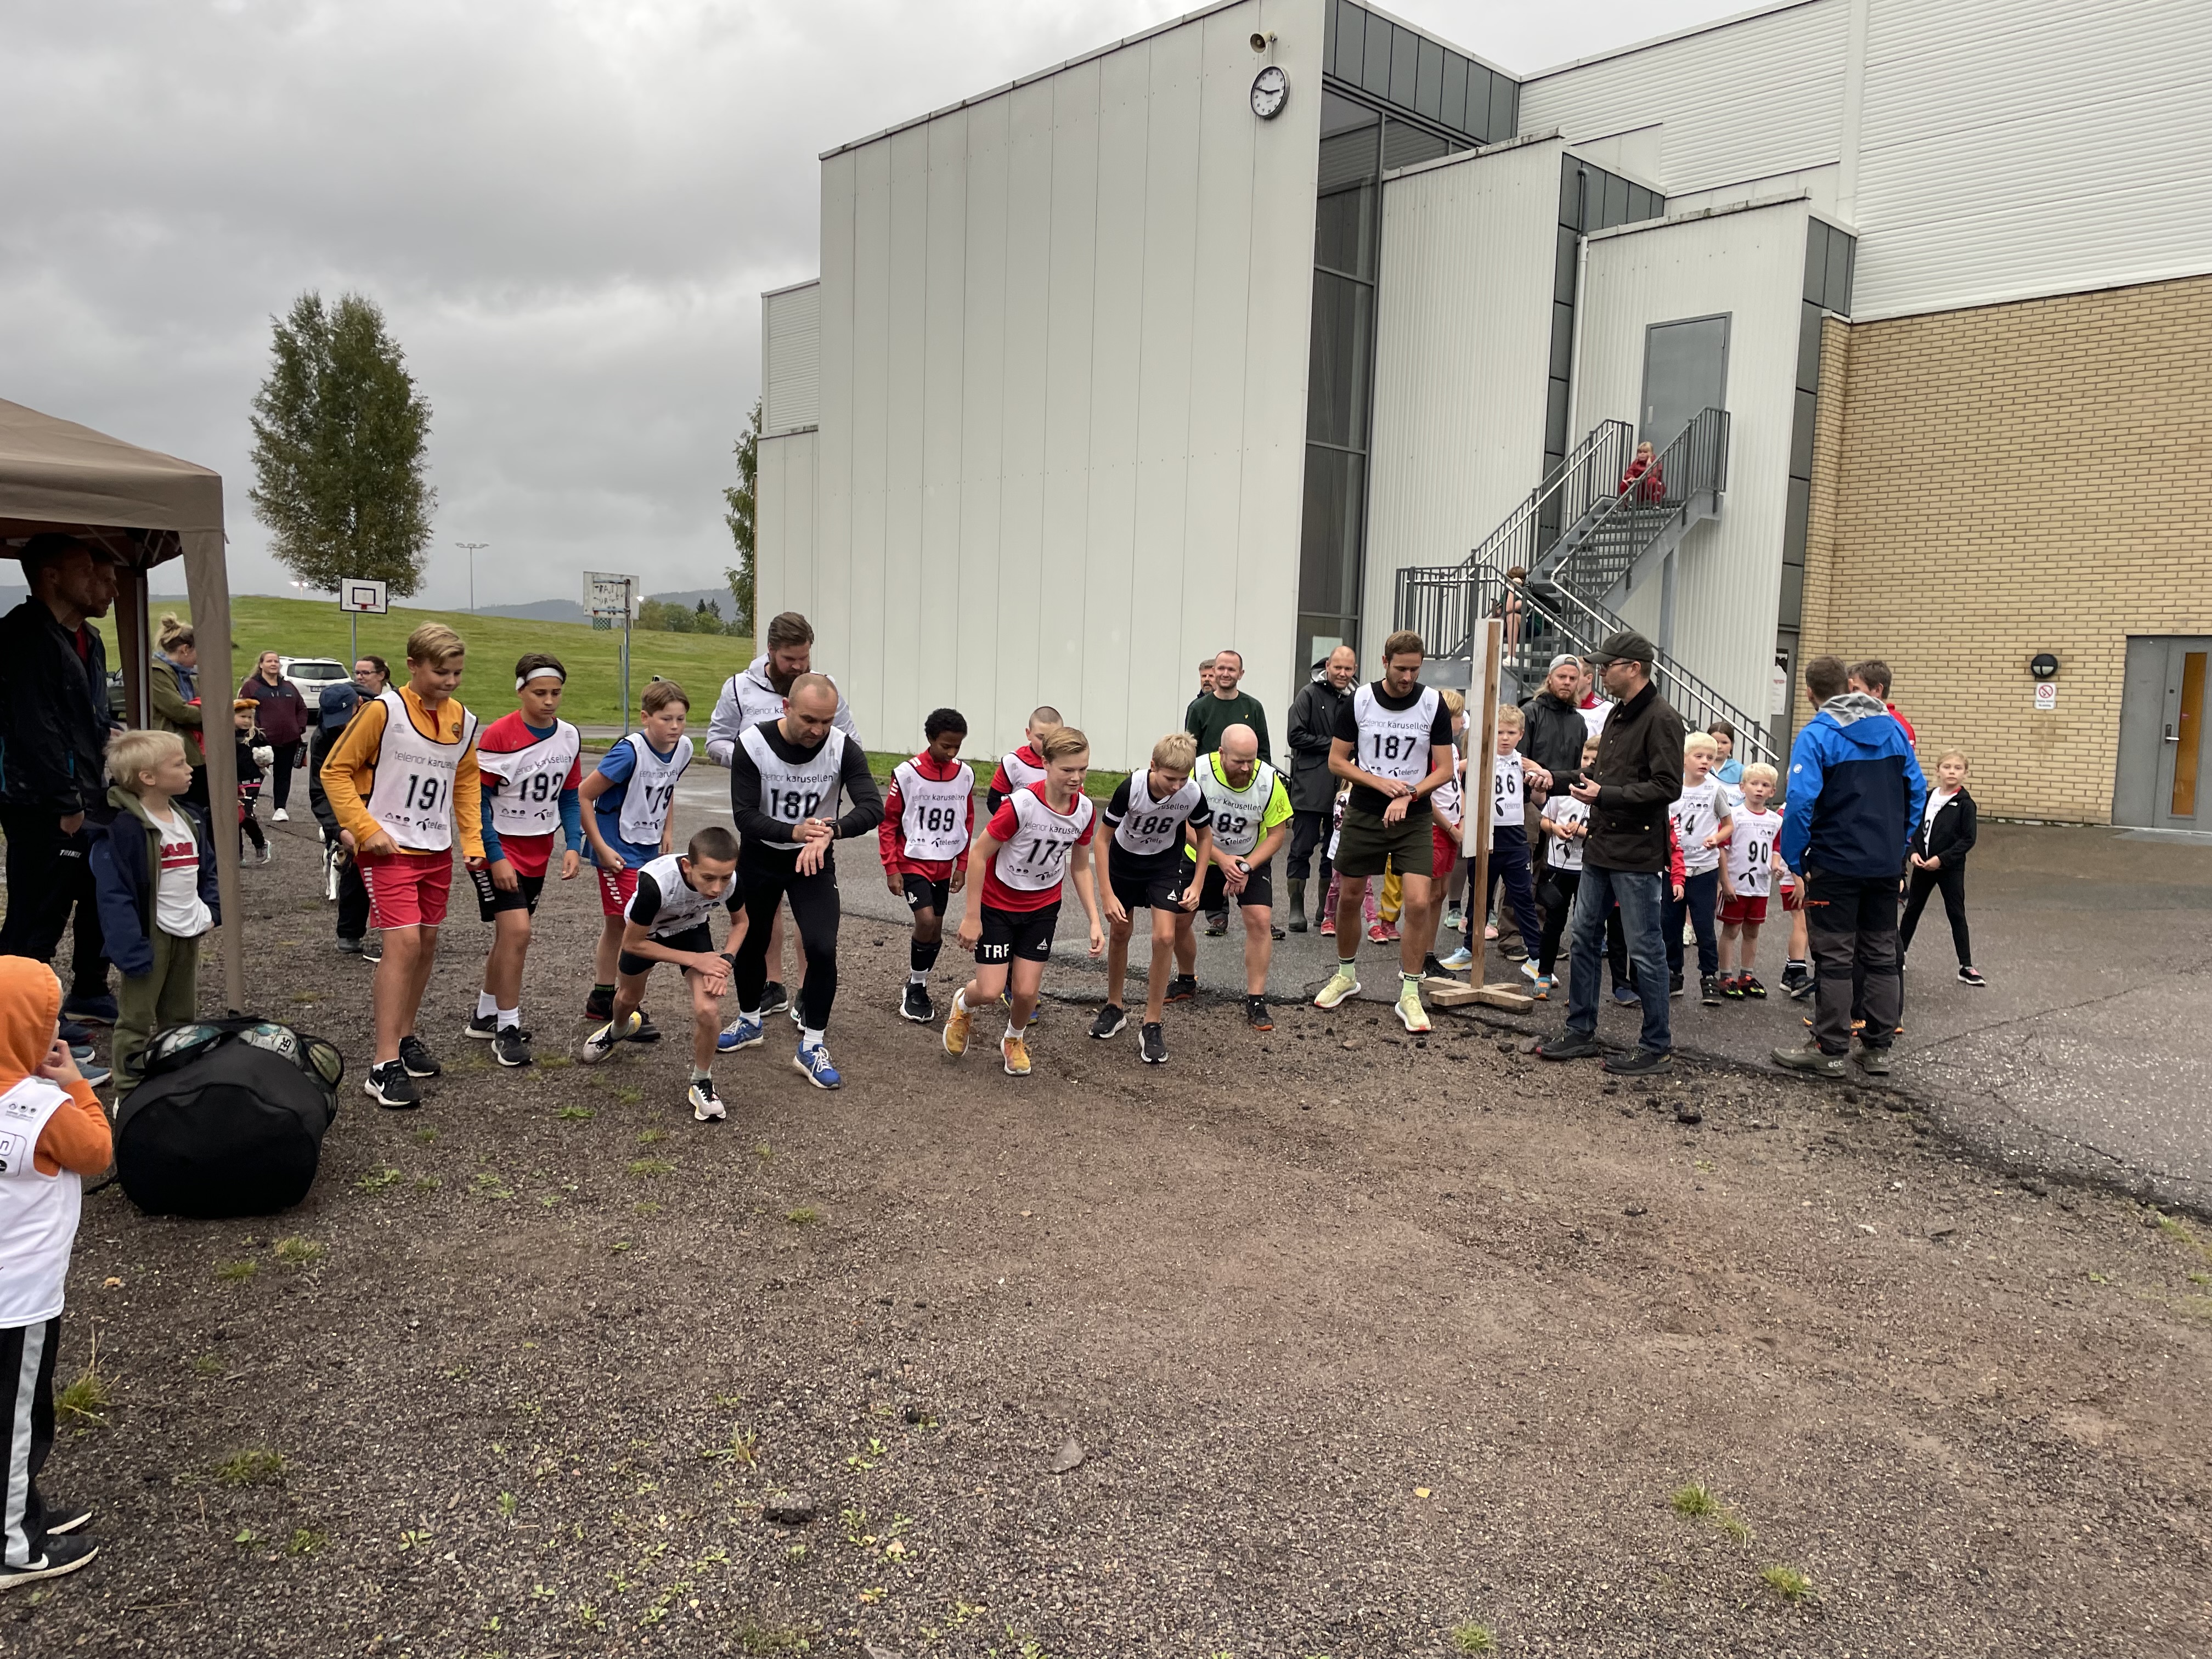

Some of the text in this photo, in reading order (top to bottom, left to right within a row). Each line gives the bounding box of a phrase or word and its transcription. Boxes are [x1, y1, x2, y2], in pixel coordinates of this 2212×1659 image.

[1387, 721, 1429, 730] karusellen
[394, 751, 426, 764] telenor
[1373, 733, 1418, 761] 187
[516, 765, 534, 775] enor
[761, 772, 833, 783] elenor karusellen
[404, 774, 448, 814] 191
[518, 772, 565, 803] 192
[1496, 774, 1515, 795] 86
[645, 783, 675, 815] 179
[770, 788, 821, 820] 180
[1206, 794, 1262, 811] lenor karusellen
[427, 821, 447, 831] tele
[918, 805, 956, 833] 189
[1132, 815, 1174, 834] 186
[1026, 838, 1074, 866] 177
[1748, 840, 1768, 864] 90
